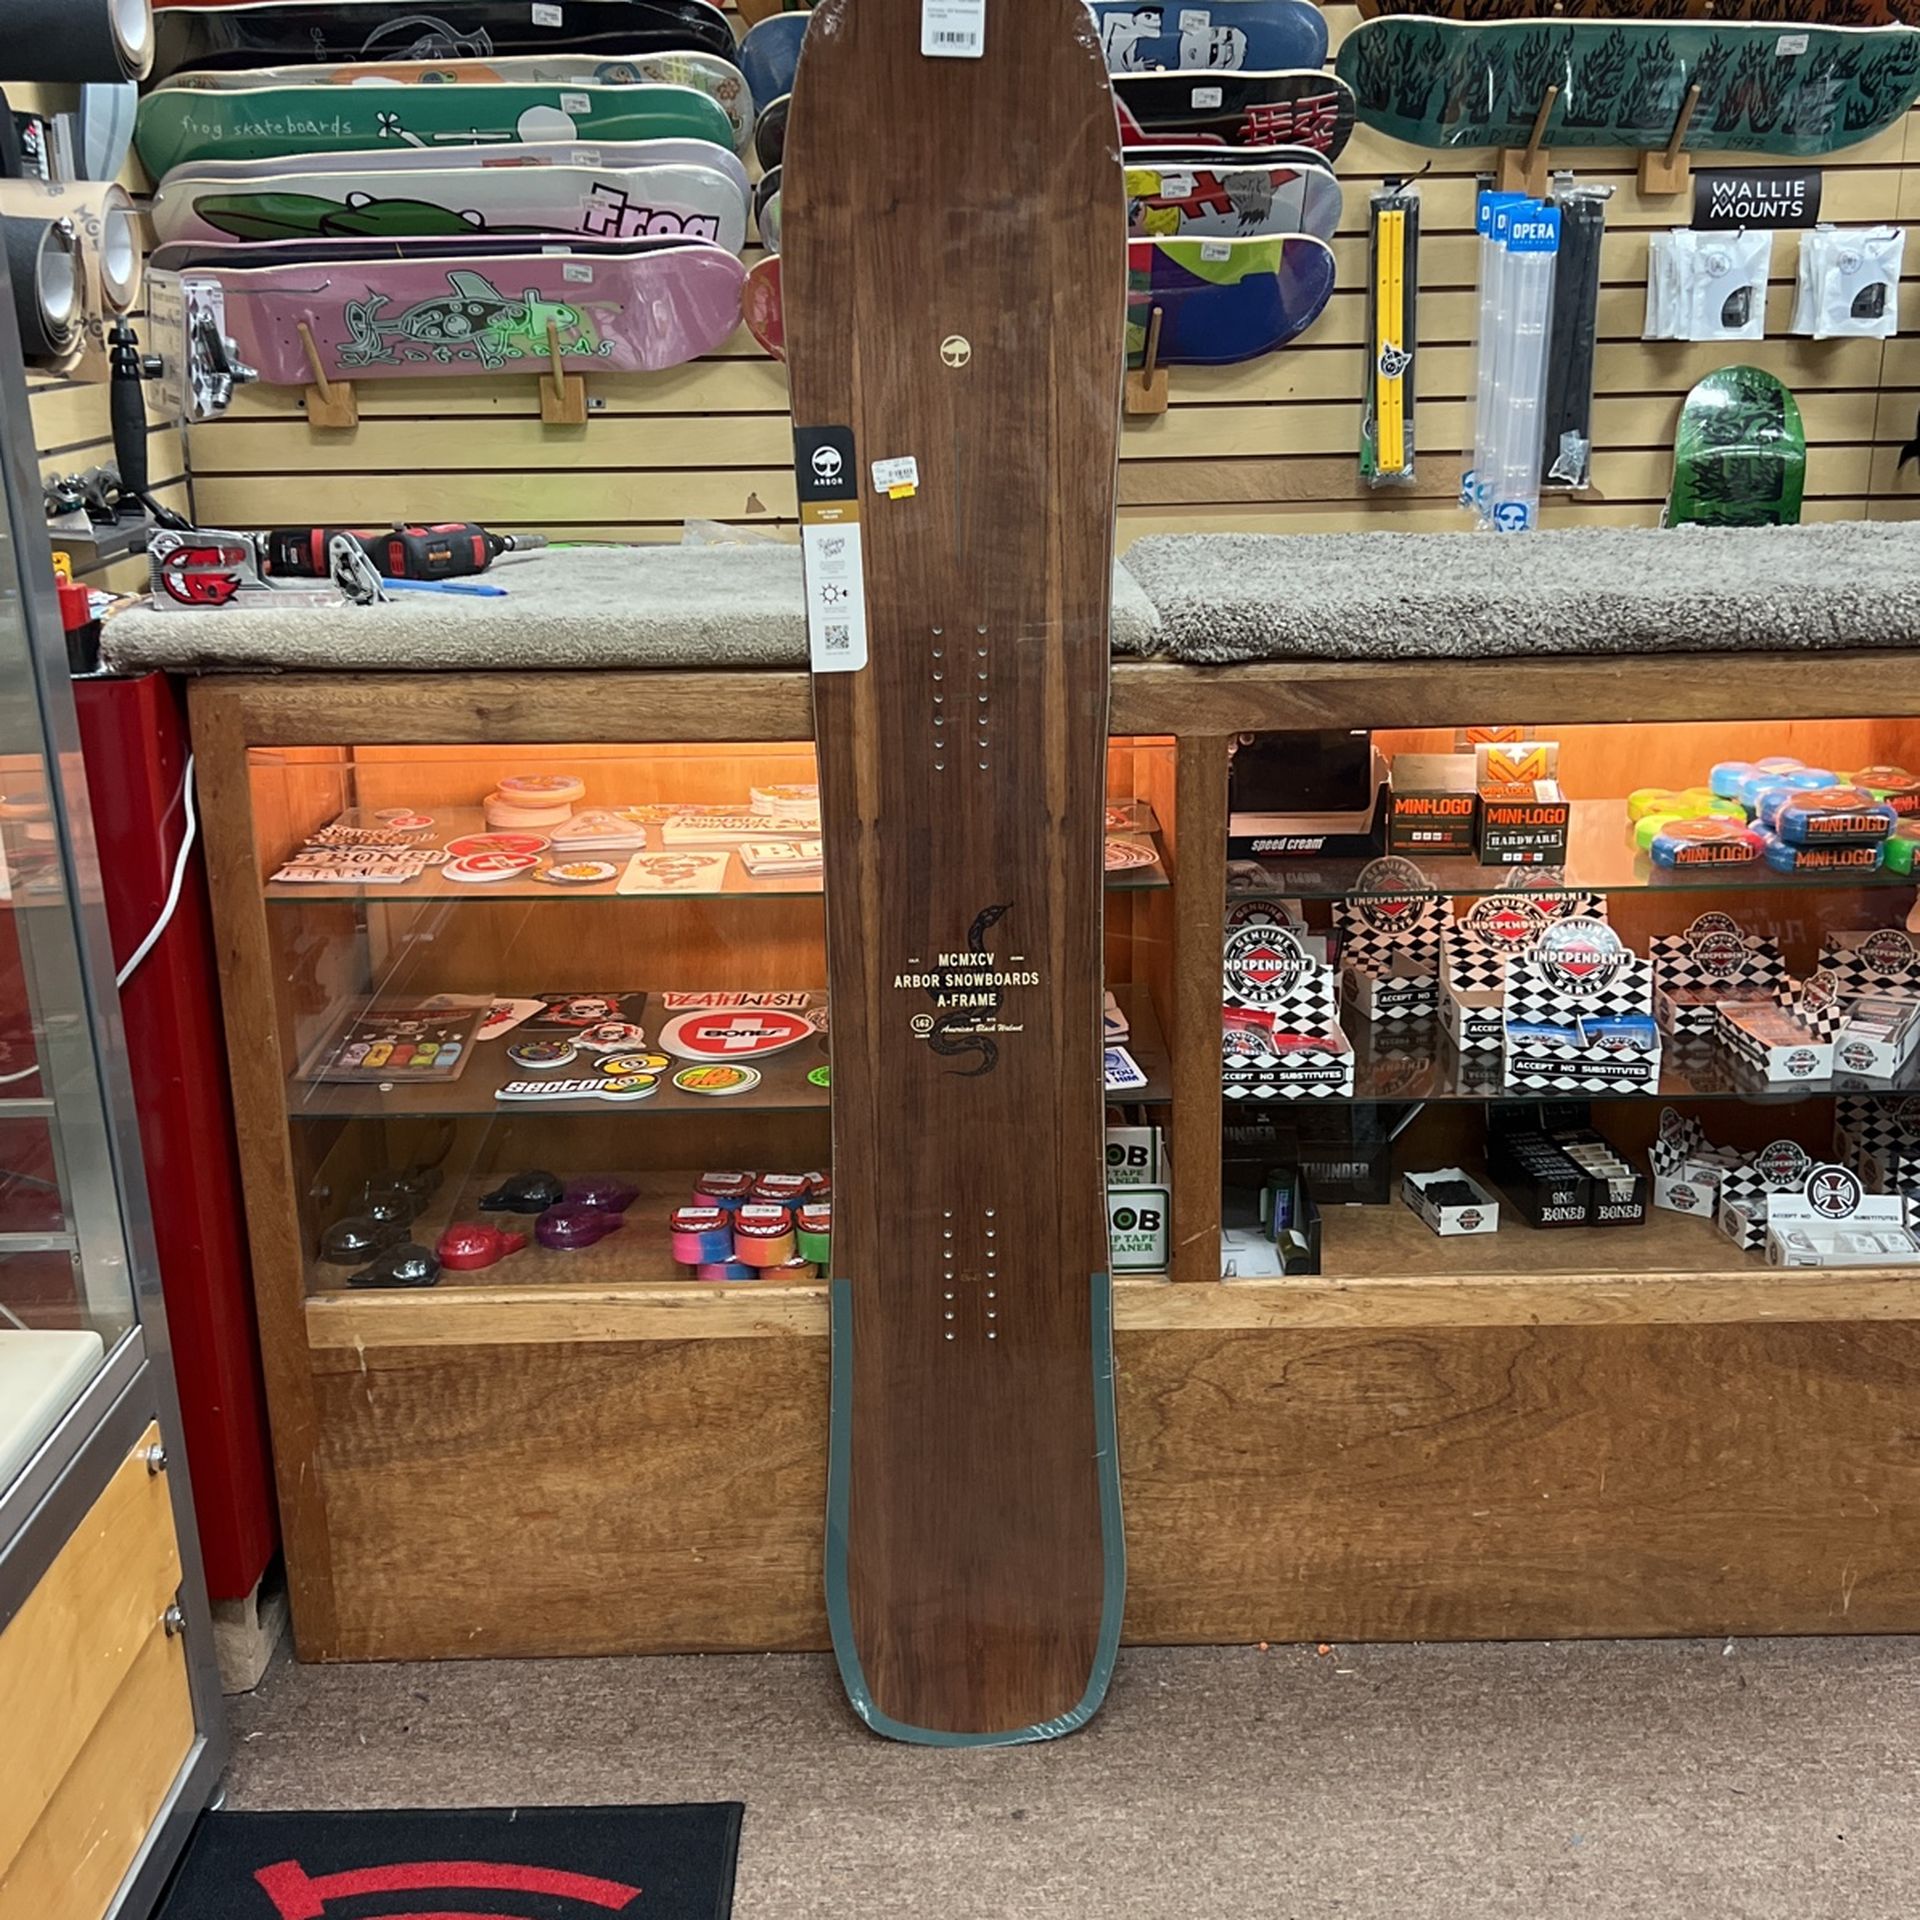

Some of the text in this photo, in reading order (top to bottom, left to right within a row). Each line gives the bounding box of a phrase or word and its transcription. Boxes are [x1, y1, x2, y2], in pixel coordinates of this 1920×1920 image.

[182, 115, 352, 140] frog skateboards
[1712, 181, 1805, 198] WALLIE
[1710, 201, 1803, 218] MOUNTS
[1513, 223, 1555, 239] OPERA
[813, 477, 844, 486] ARBOR
[1395, 799, 1473, 815] MINI-LOGO
[1488, 809, 1566, 824] MINI-LOGO
[1251, 837, 1323, 852] speed cream
[1491, 833, 1558, 846] HARDWARE
[1374, 918, 1414, 933] PARTS
[1467, 919, 1554, 930] INDEPENDENT
[1552, 921, 1614, 940] GENUINE
[1235, 931, 1292, 949] GENUINE
[938, 953, 995, 967] MCMXCV
[1533, 951, 1627, 963] INDEPENDENT
[1223, 960, 1309, 972] NDEPENDENT
[894, 972, 1040, 988] ARBOR SNOWBOARDS
[1554, 979, 1602, 994] PARTS
[667, 992, 805, 1007] DEATHWISH
[1240, 986, 1287, 1001] PARTS
[1381, 995, 1413, 1003] ACCEPT
[1280, 1071, 1342, 1080] SUBSTITUTES
[1516, 1061, 1554, 1071] ACCEPT
[1582, 1066, 1647, 1075] SUBSTITUTES
[505, 1079, 617, 1093] sector
[1106, 1144, 1149, 1167] OB
[1302, 1163, 1370, 1179] THUNDER
[1113, 1207, 1161, 1231] OB
[1124, 1235, 1157, 1243] TAPE
